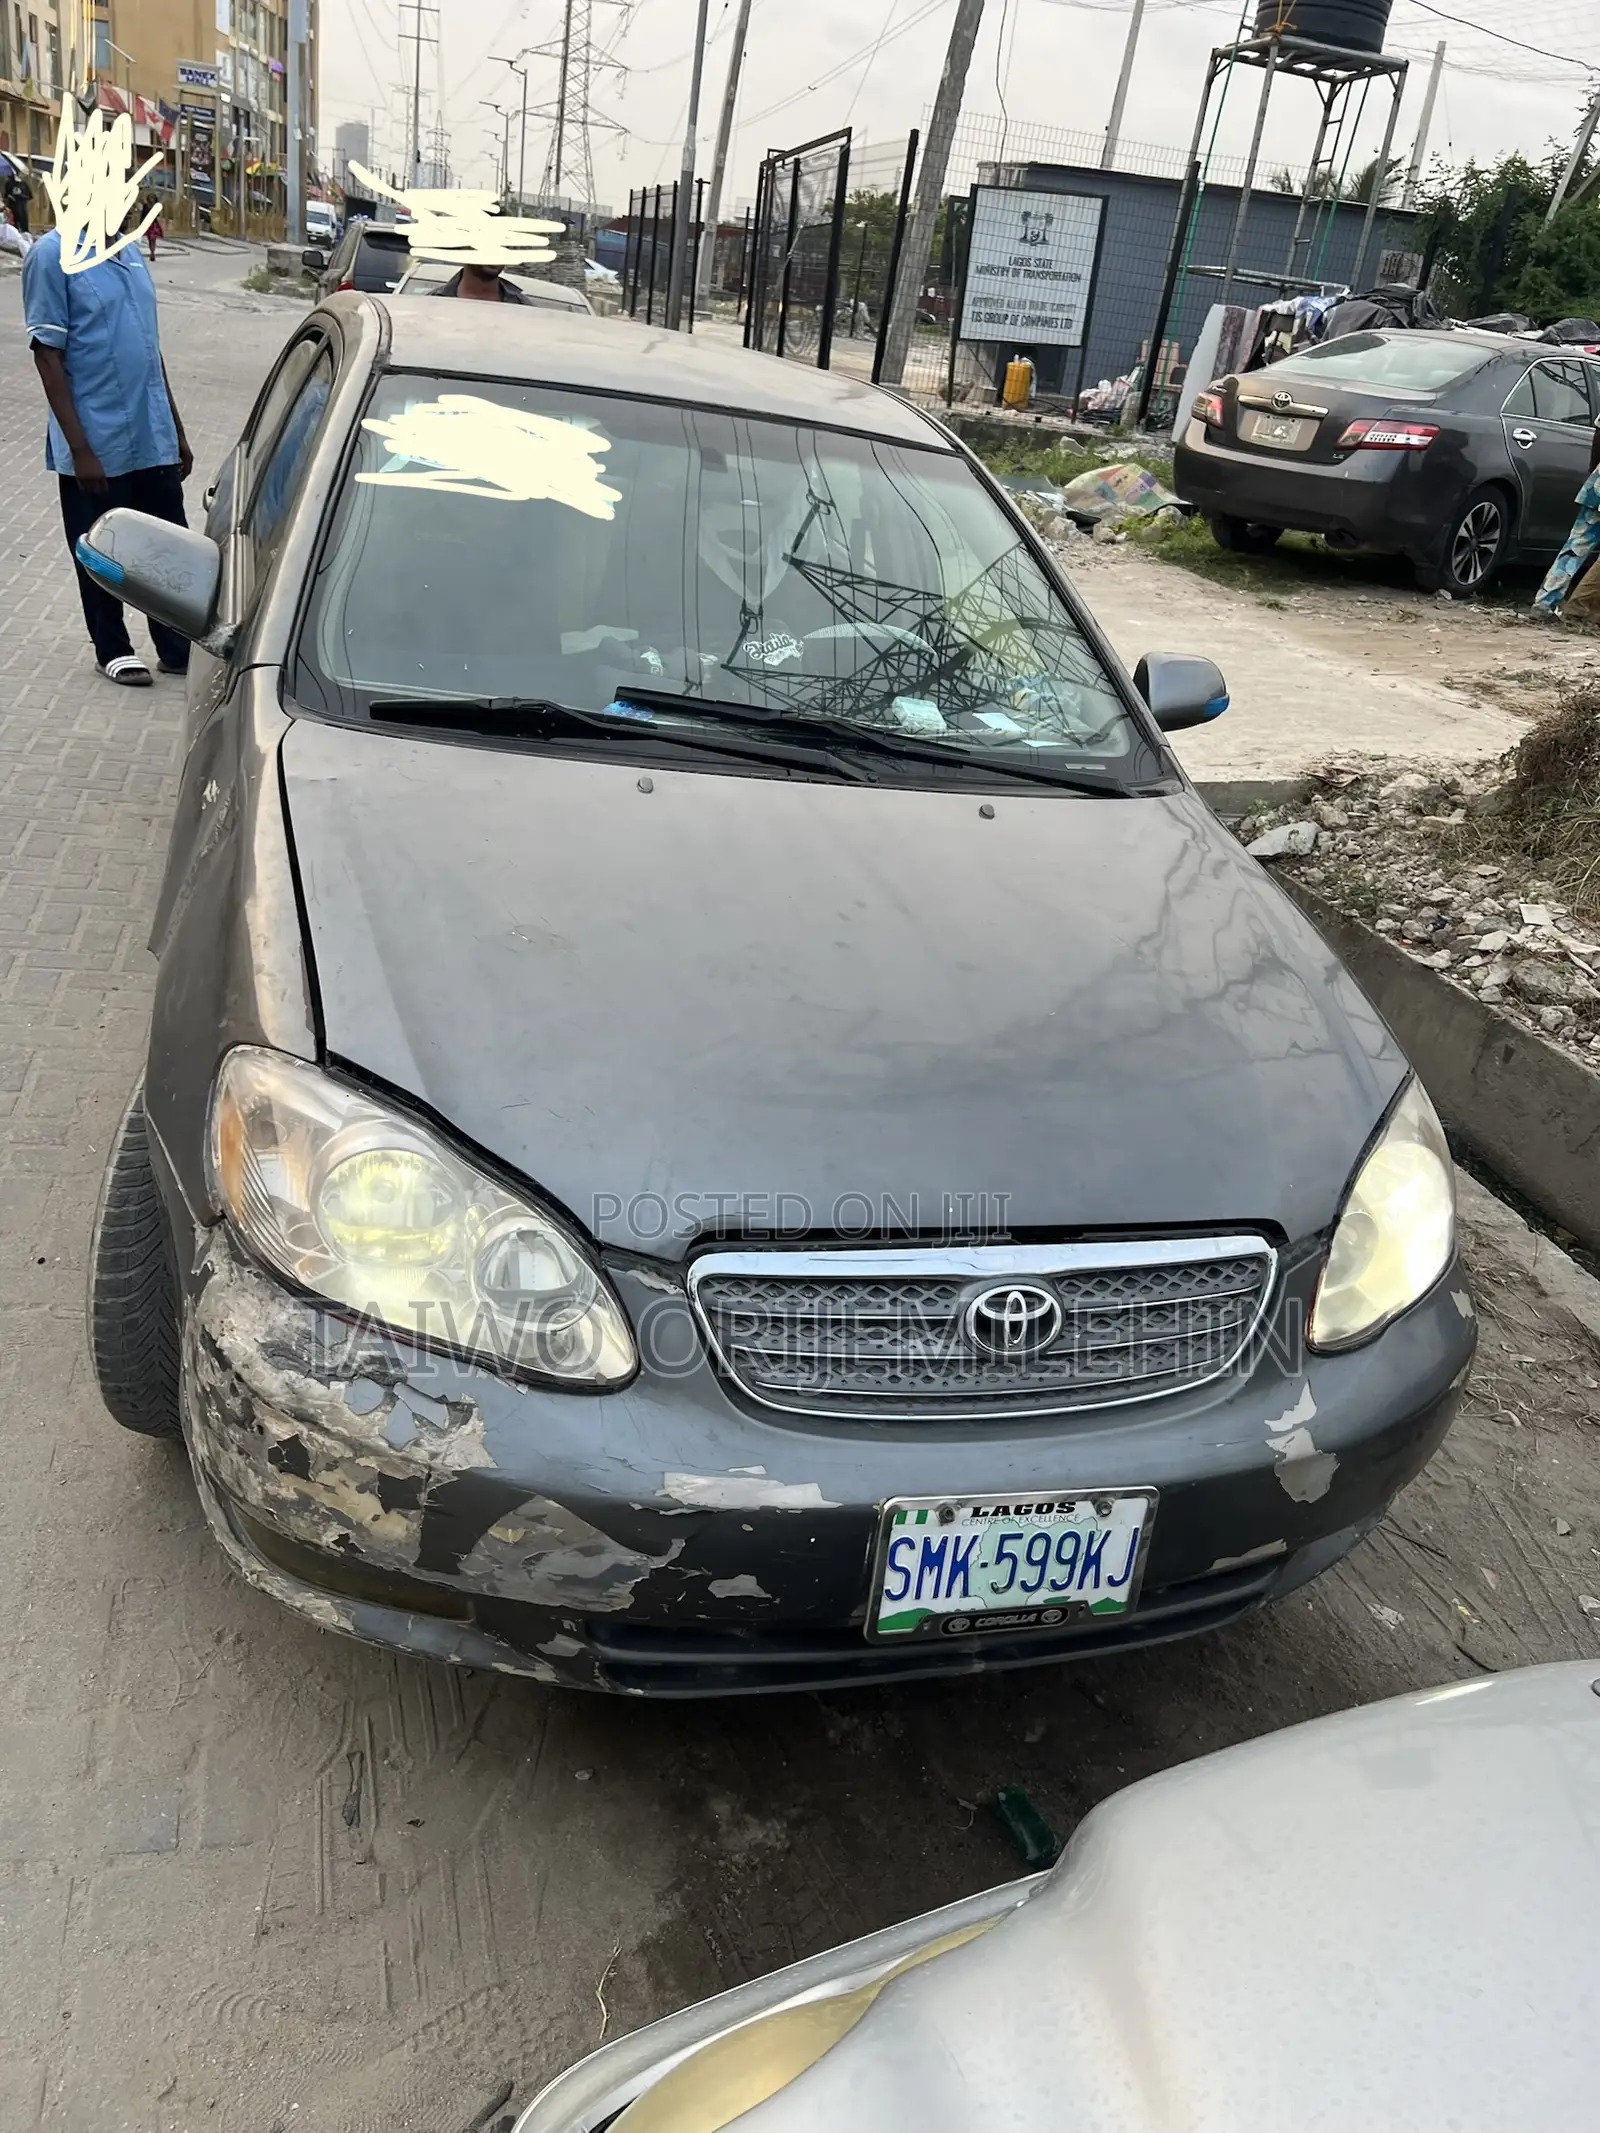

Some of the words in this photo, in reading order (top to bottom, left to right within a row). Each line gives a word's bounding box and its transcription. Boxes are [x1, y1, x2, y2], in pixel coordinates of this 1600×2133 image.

[1009, 256, 1032, 268] LAGOS
[1034, 258, 1053, 269] STATE
[976, 264, 1010, 278] MINISTRY
[1012, 267, 1020, 278] OF
[1022, 268, 1082, 283] TRANSPORTATION
[984, 312, 1009, 325] GROUP
[1010, 314, 1020, 326] OF
[1021, 315, 1059, 329] COMPANIES
[970, 1501, 1077, 1518] LAGOS
[961, 1516, 1000, 1527] CENTRE
[1001, 1517, 1016, 1525] OF
[1018, 1513, 1080, 1524] EXCELLENCE
[884, 1527, 1141, 1601] SMK-599KJ
[975, 1613, 1038, 1628] COROLLA
